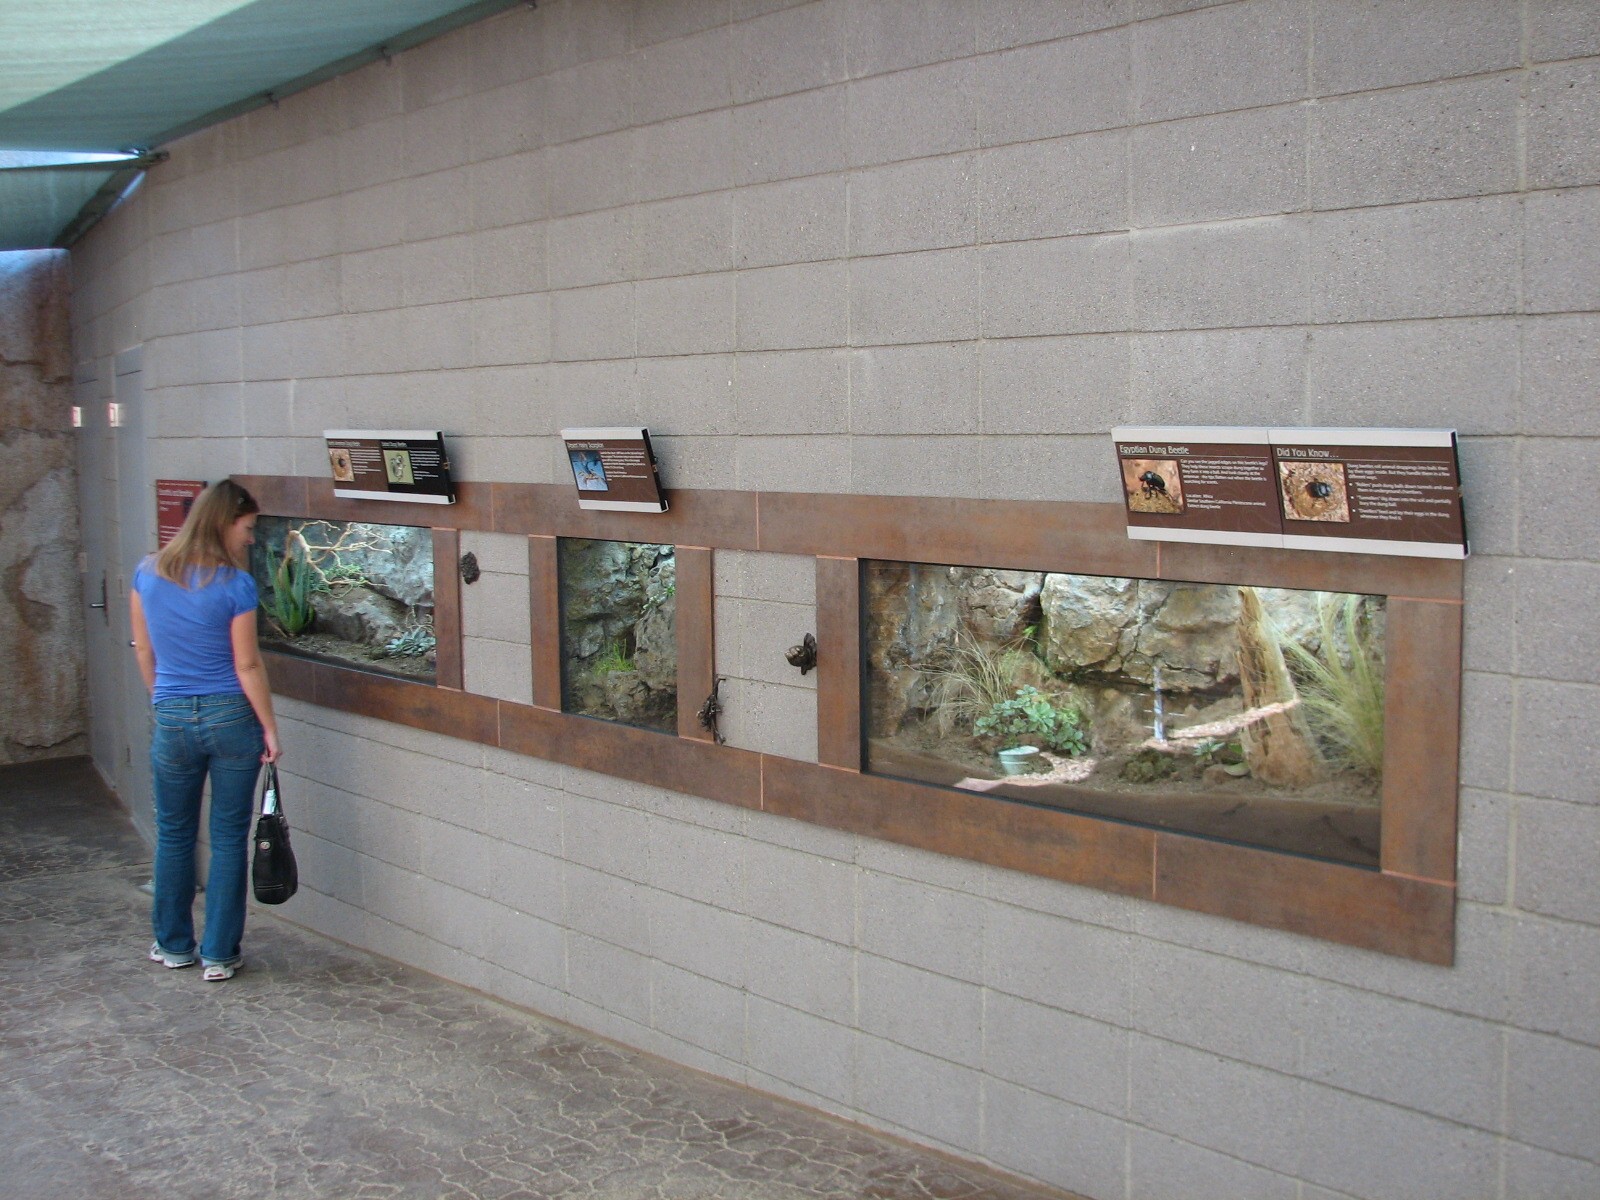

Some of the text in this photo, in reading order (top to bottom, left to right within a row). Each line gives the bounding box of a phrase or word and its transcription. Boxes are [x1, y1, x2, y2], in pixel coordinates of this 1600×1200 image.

[1120, 445, 1190, 455] Egyptian Dung Beetle
[1276, 448, 1290, 457] Did
[1291, 449, 1306, 457] You
